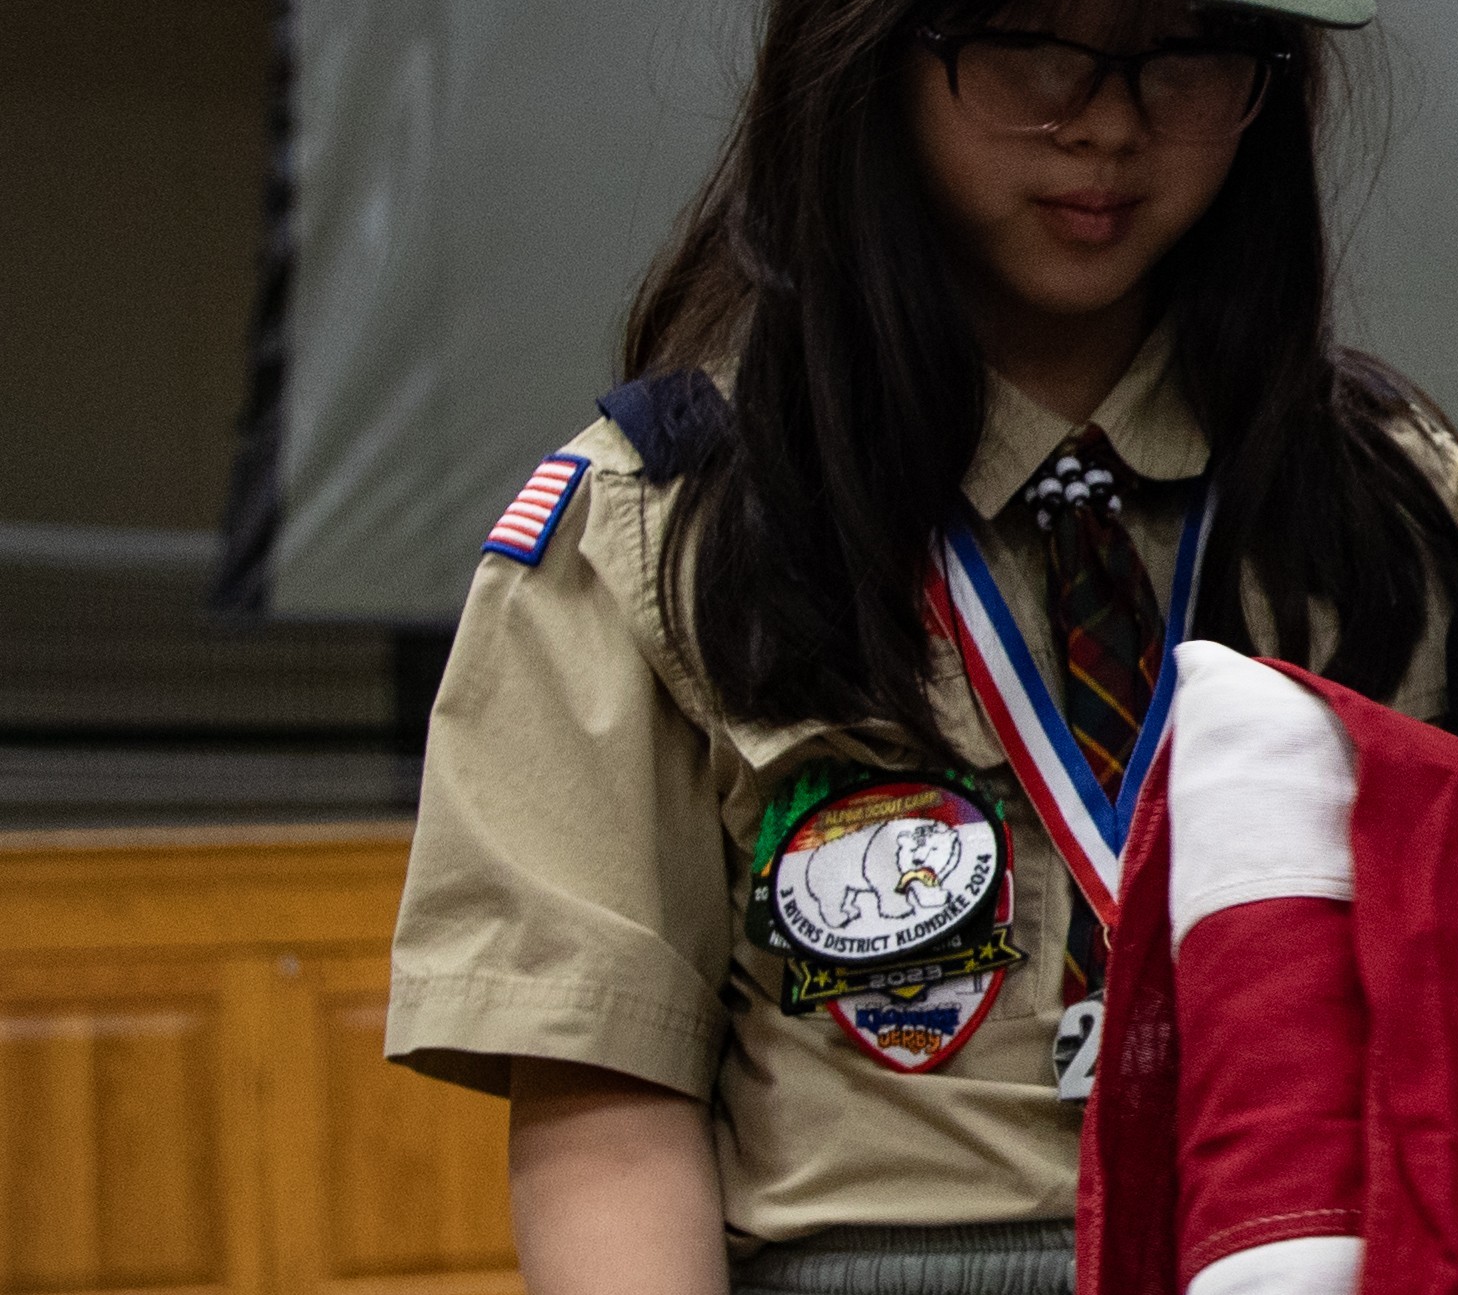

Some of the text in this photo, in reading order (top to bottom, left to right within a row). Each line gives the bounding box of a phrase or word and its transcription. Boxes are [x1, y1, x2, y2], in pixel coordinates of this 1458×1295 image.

[965, 853, 992, 896] 2024
[780, 886, 794, 899] 3
[783, 897, 824, 944] RIVERS
[896, 893, 970, 946] KLONDIKE
[823, 932, 890, 953] DISTRICT
[869, 965, 942, 989] 2023
